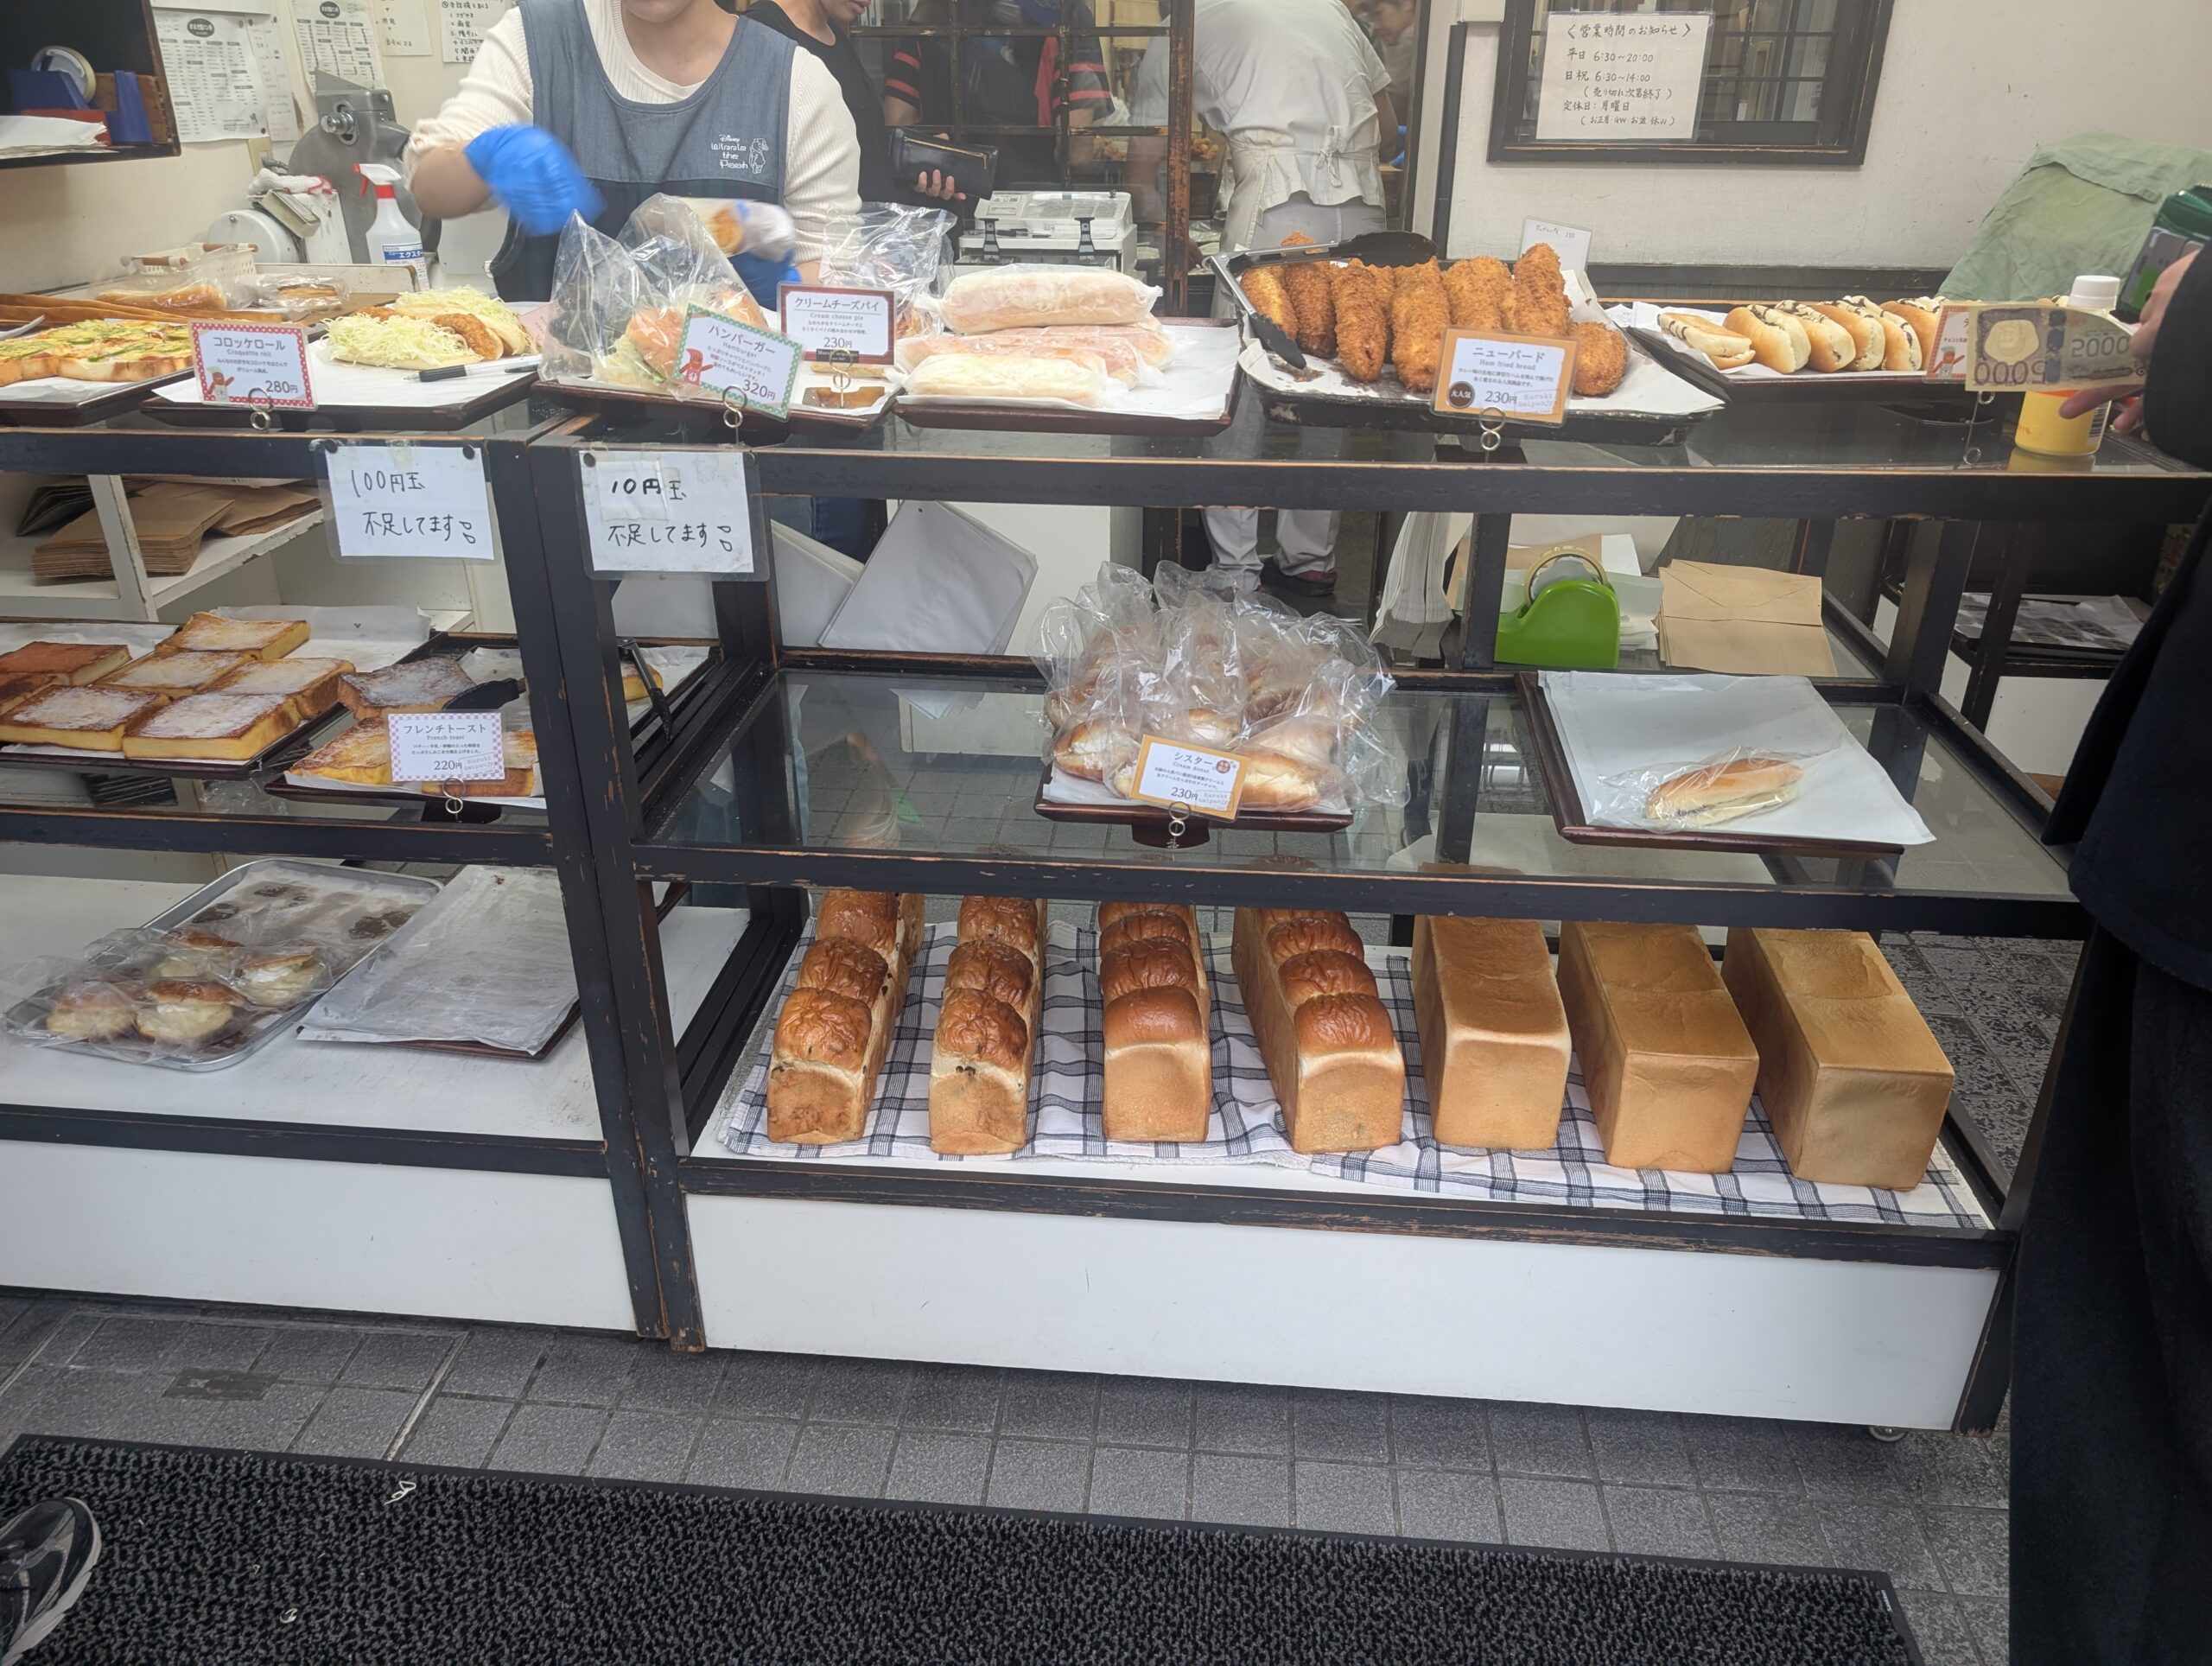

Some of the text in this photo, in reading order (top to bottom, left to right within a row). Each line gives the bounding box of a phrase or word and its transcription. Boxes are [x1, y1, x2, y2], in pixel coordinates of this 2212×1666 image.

[1567, 48, 1586, 60] 平日
[1565, 70, 1589, 82] 日祝
[722, 151, 739, 160] the
[719, 159, 748, 169] Pooh
[794, 297, 880, 312] クリームチーズパイ
[213, 336, 286, 351] コロッケロール
[708, 325, 776, 354] ハンバーガー
[823, 336, 853, 348] 230円
[226, 348, 258, 357] Croquette
[722, 342, 757, 359] Hamburger
[1472, 347, 1546, 363] ニューバード
[1497, 359, 1514, 368] fried
[1516, 362, 1535, 371] bread
[265, 380, 298, 394] 280円
[741, 379, 776, 400] 320円
[1451, 390, 1471, 399] 大人気
[1484, 391, 1517, 404] 230円
[351, 469, 426, 498] 100円玉
[611, 478, 688, 500] 10円玉
[362, 511, 454, 542] 不足してます
[607, 522, 707, 548] 不足してます
[404, 723, 486, 734] フレンチトースト
[434, 760, 462, 771] 220円
[1173, 761, 1192, 770] Cream
[1174, 752, 1213, 766] シスター
[1171, 786, 1198, 801] 230円
